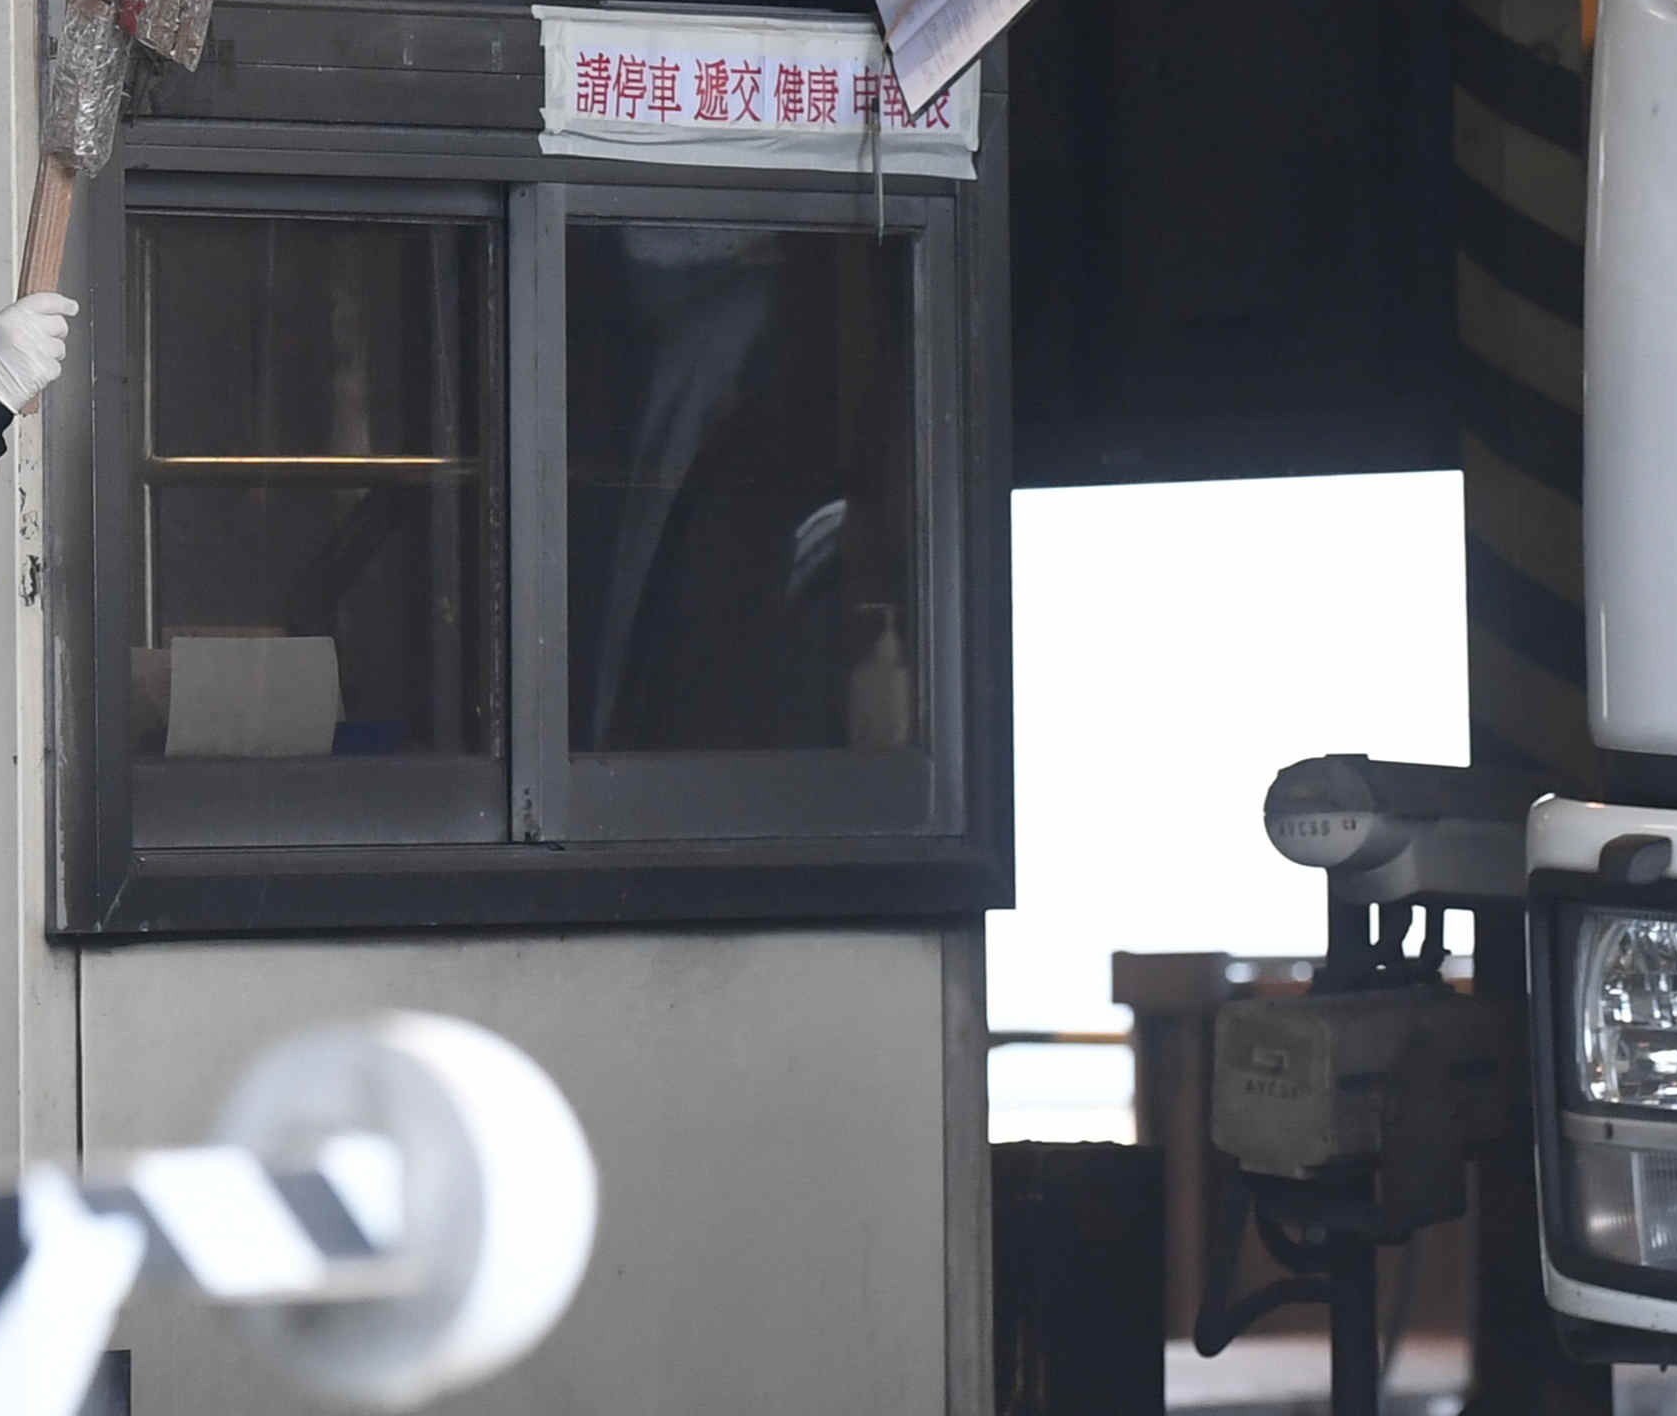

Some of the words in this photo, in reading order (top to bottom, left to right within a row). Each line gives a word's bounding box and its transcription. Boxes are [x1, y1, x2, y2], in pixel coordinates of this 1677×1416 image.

[575, 50, 682, 122] 請停車
[694, 57, 762, 123] 遞交
[773, 63, 840, 126] 健康
